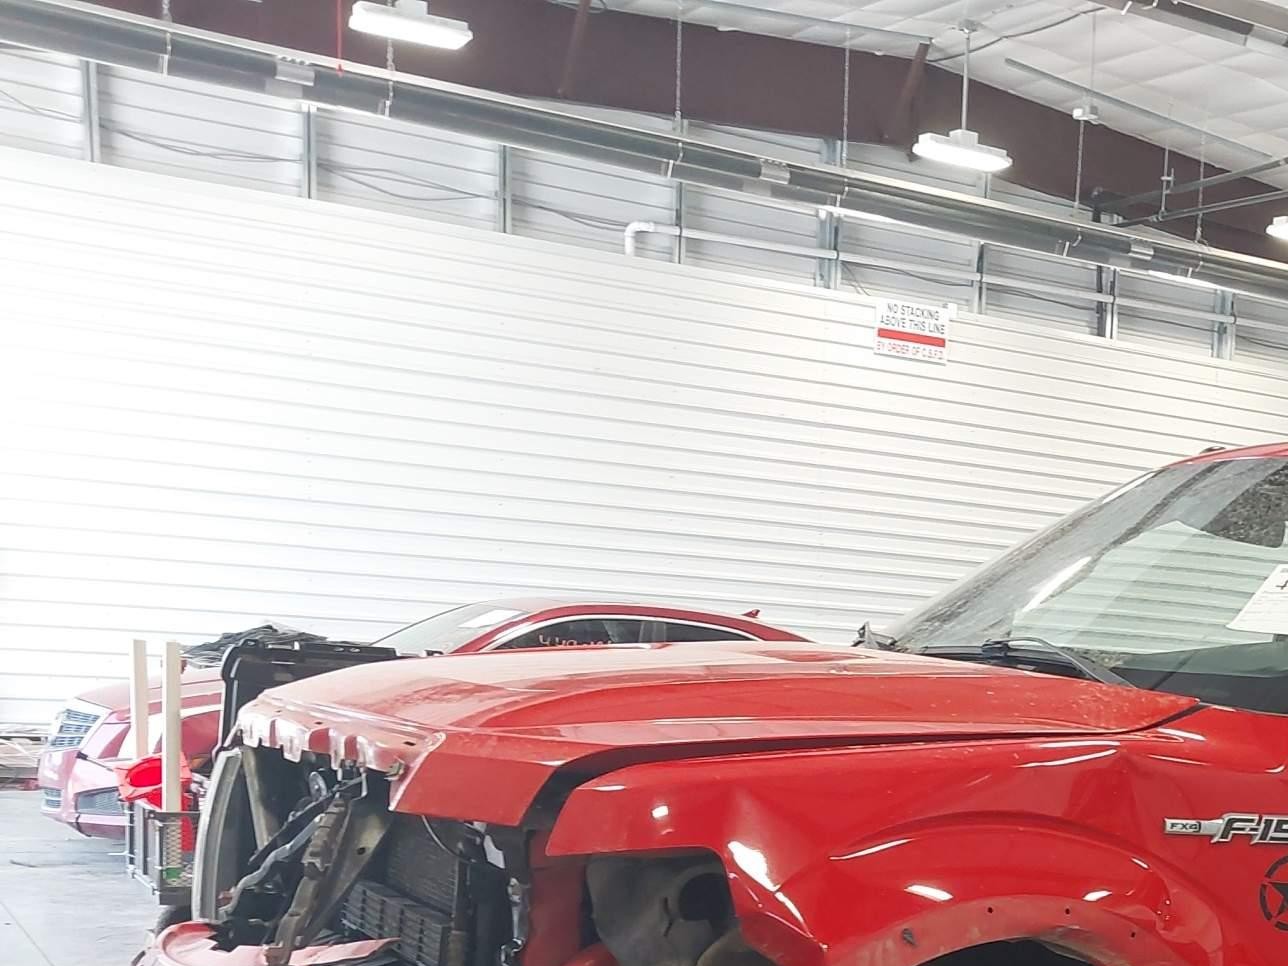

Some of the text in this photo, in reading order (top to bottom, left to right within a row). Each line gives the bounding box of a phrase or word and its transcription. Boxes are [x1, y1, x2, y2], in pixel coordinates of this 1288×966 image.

[887, 303, 940, 321] NO STACKING
[880, 314, 945, 335] ABOVE THIS LINE
[1169, 822, 1199, 832] FX4
